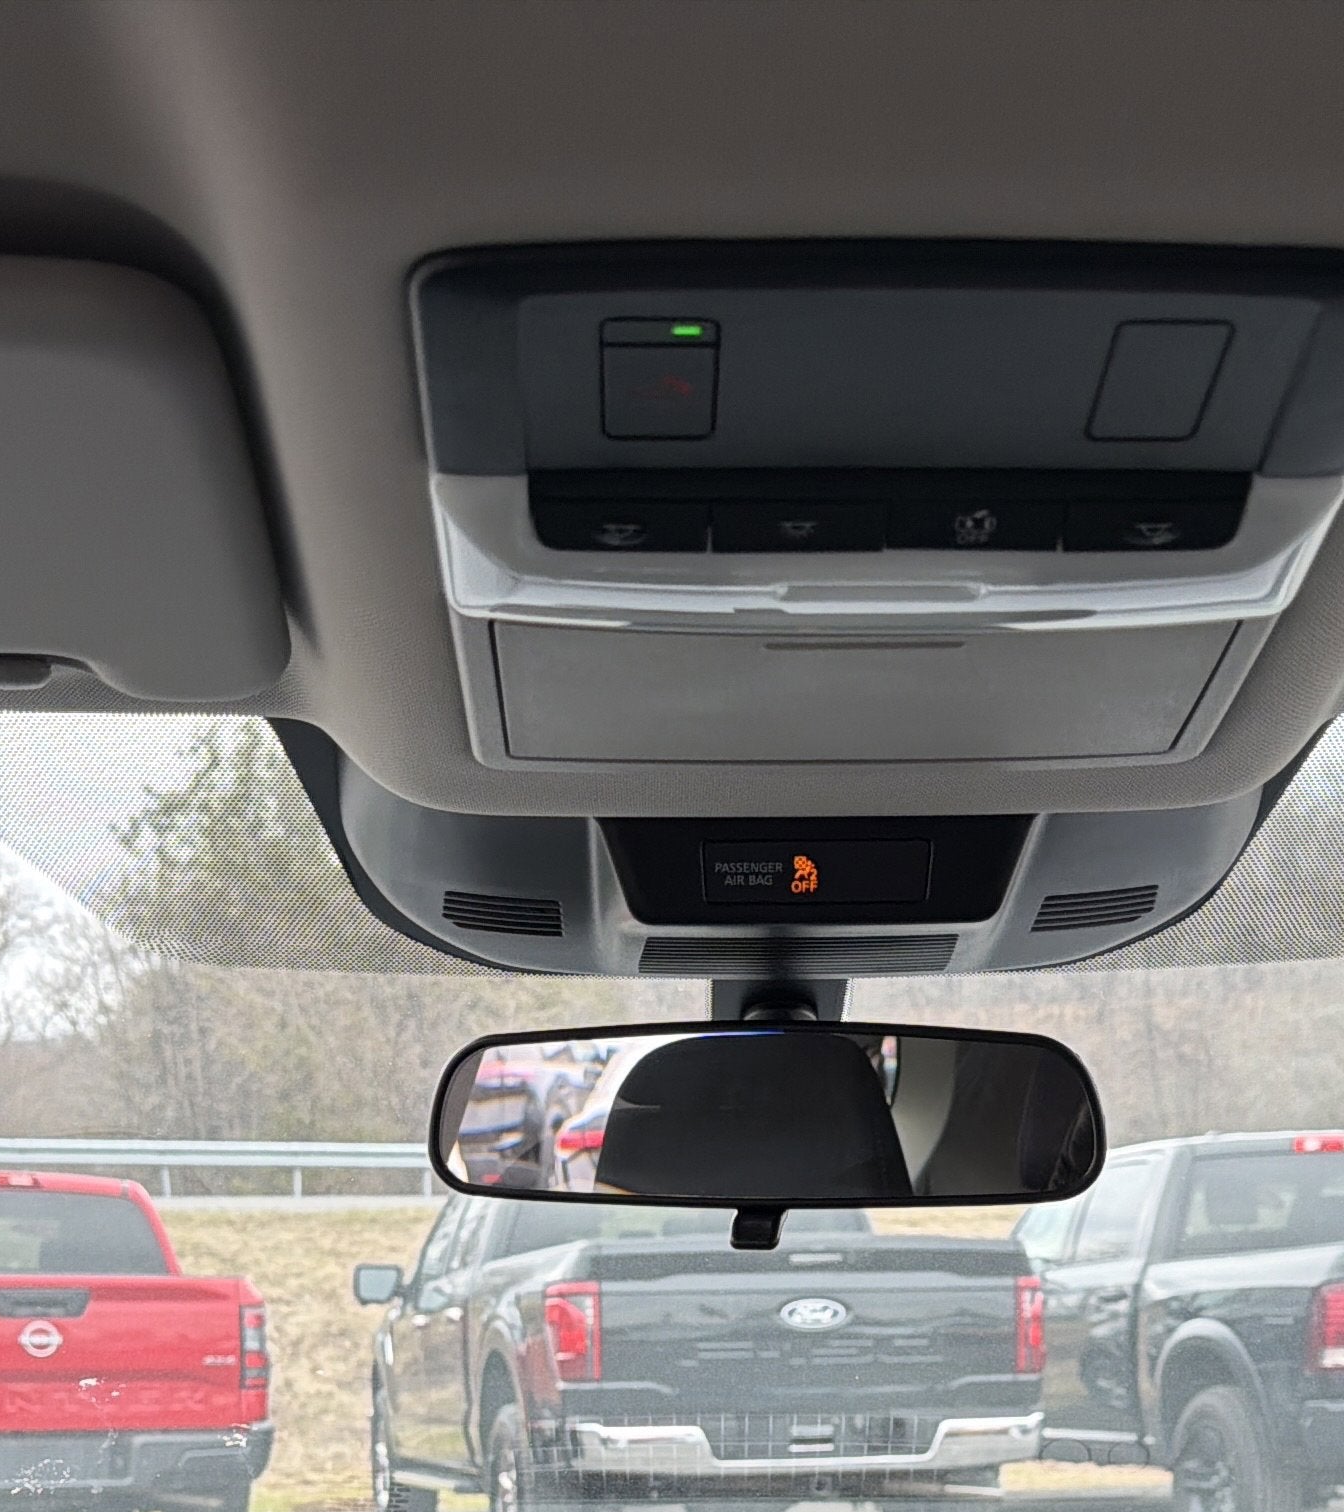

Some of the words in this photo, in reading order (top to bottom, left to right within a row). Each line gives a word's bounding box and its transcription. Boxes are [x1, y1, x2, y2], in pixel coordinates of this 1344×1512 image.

[714, 862, 783, 872] PASSENGER
[724, 874, 745, 886] AIR
[748, 874, 773, 886] BAG
[791, 880, 818, 893] OFF
